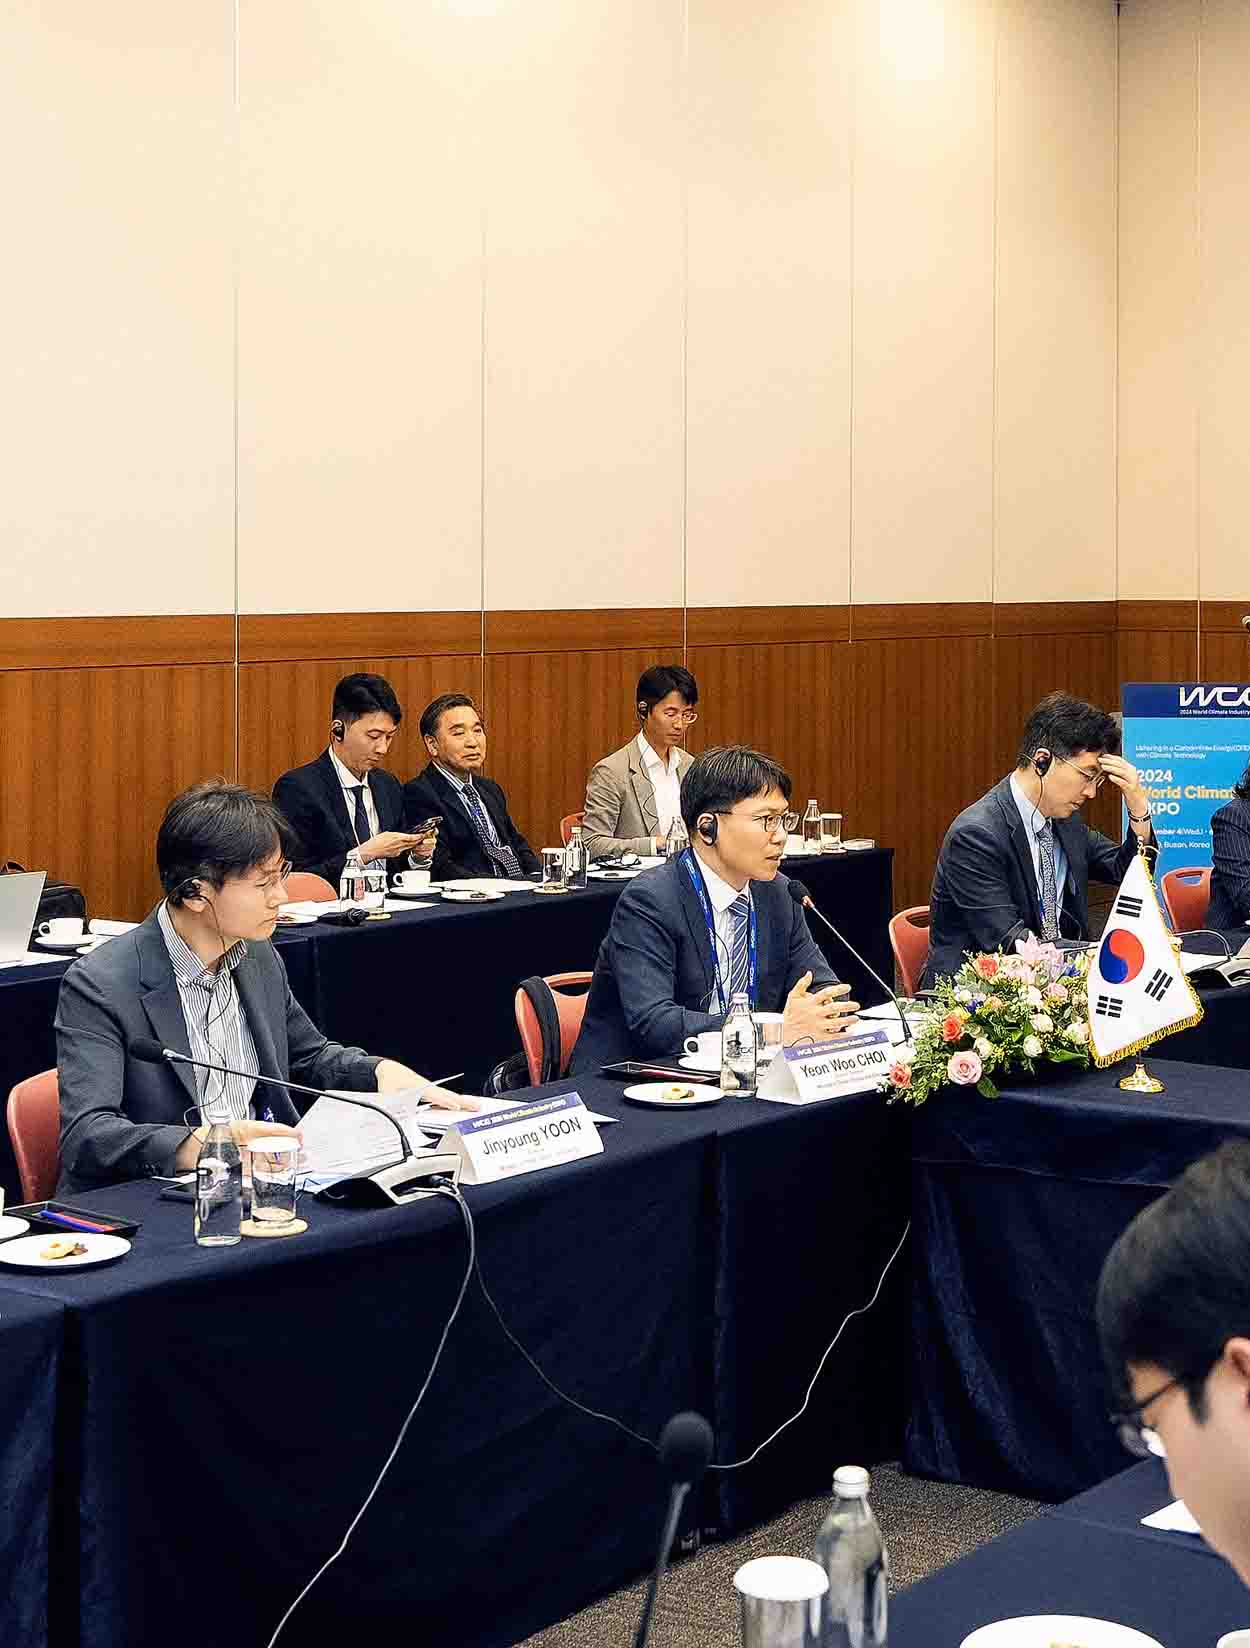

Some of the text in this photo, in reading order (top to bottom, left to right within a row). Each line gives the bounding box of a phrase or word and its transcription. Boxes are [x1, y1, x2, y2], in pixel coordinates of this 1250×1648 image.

[1136, 769, 1173, 783] 2024
[1147, 801, 1181, 816] XPO
[800, 1050, 887, 1078] Yeon Woo CHOI
[483, 1116, 582, 1155] Jinyoung YOON
